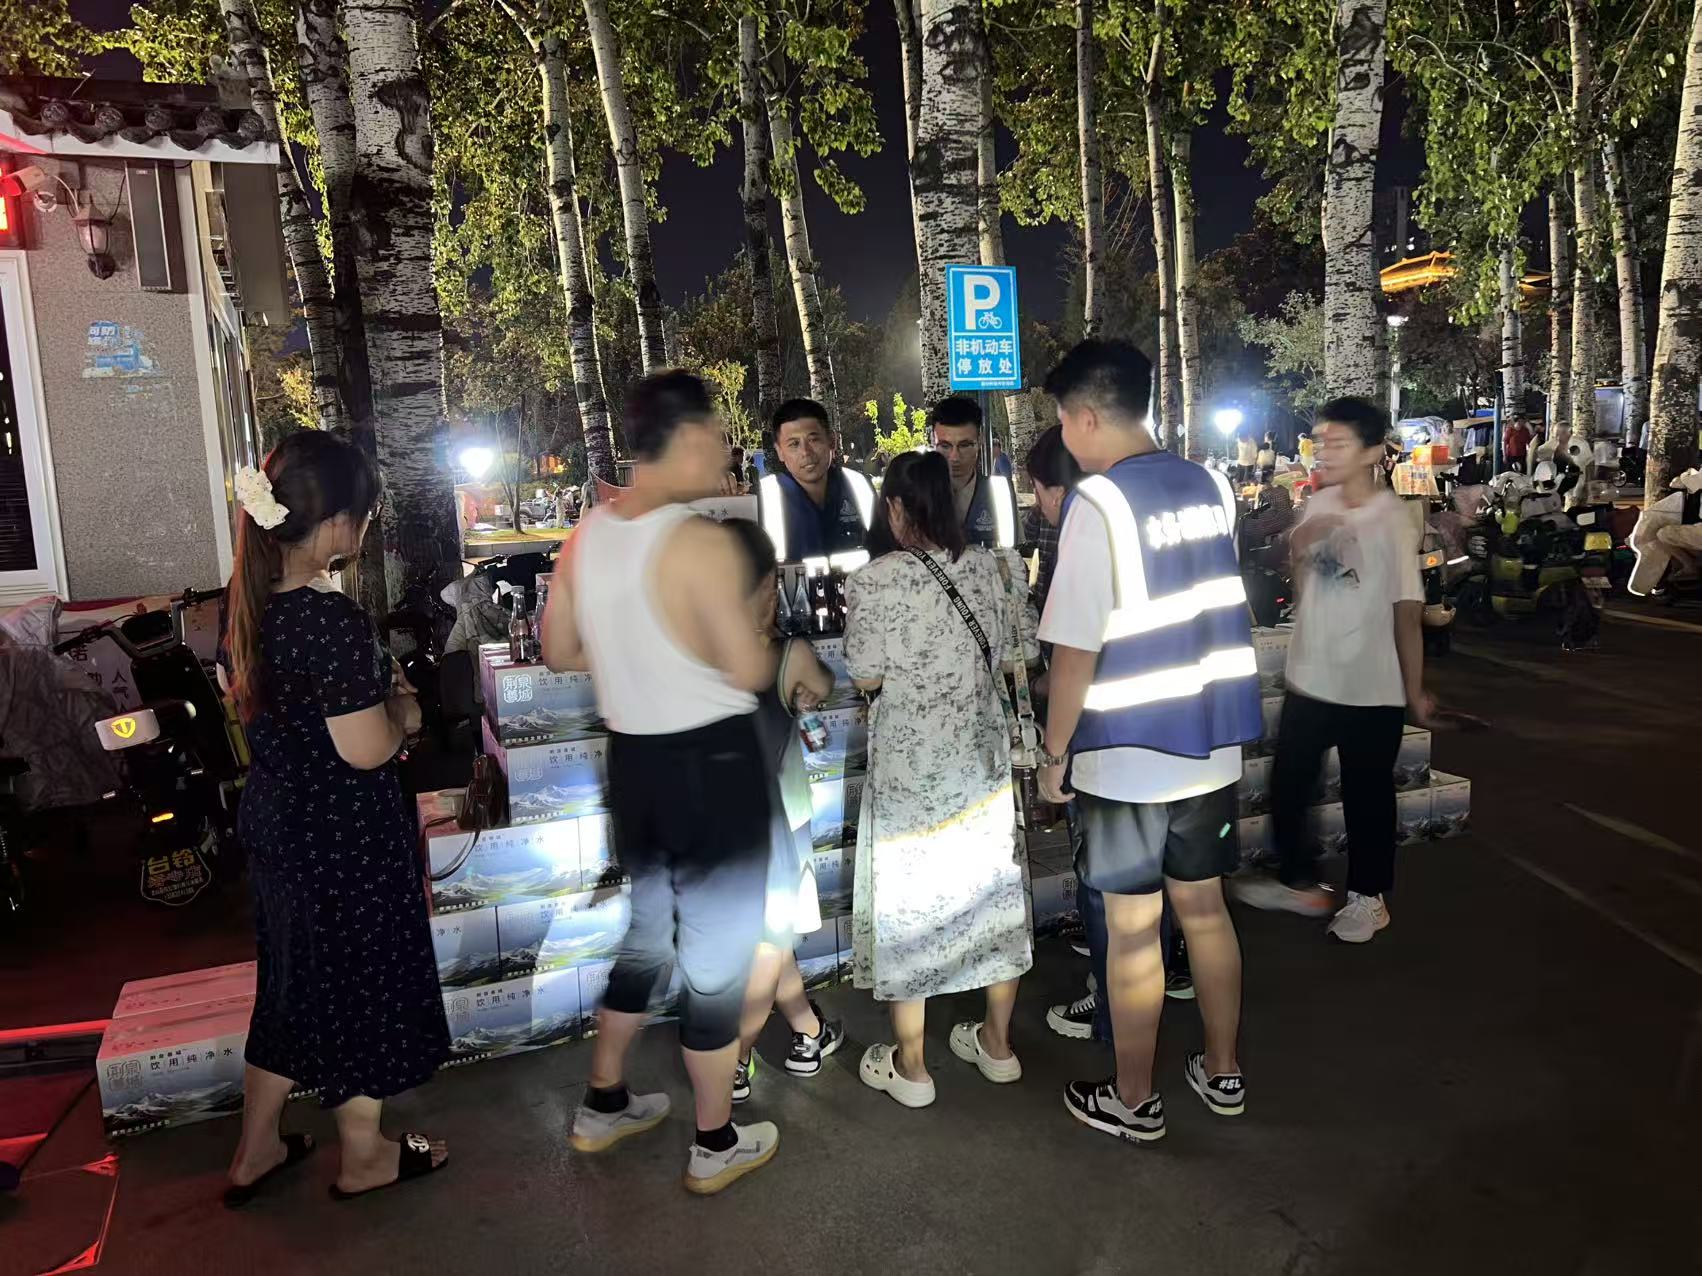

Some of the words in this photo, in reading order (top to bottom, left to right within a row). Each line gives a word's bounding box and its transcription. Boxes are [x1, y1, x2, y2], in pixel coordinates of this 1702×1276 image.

[964, 275, 1000, 329] P
[956, 338, 1013, 355] 非机动车
[957, 357, 1013, 374] 停放处
[925, 559, 952, 590] FOREVER
[953, 596, 971, 620] YOUNG
[968, 619, 987, 649] FOREVER
[476, 986, 545, 1007] 饮用纯净水
[150, 1048, 233, 1071] 饮用纯净水
